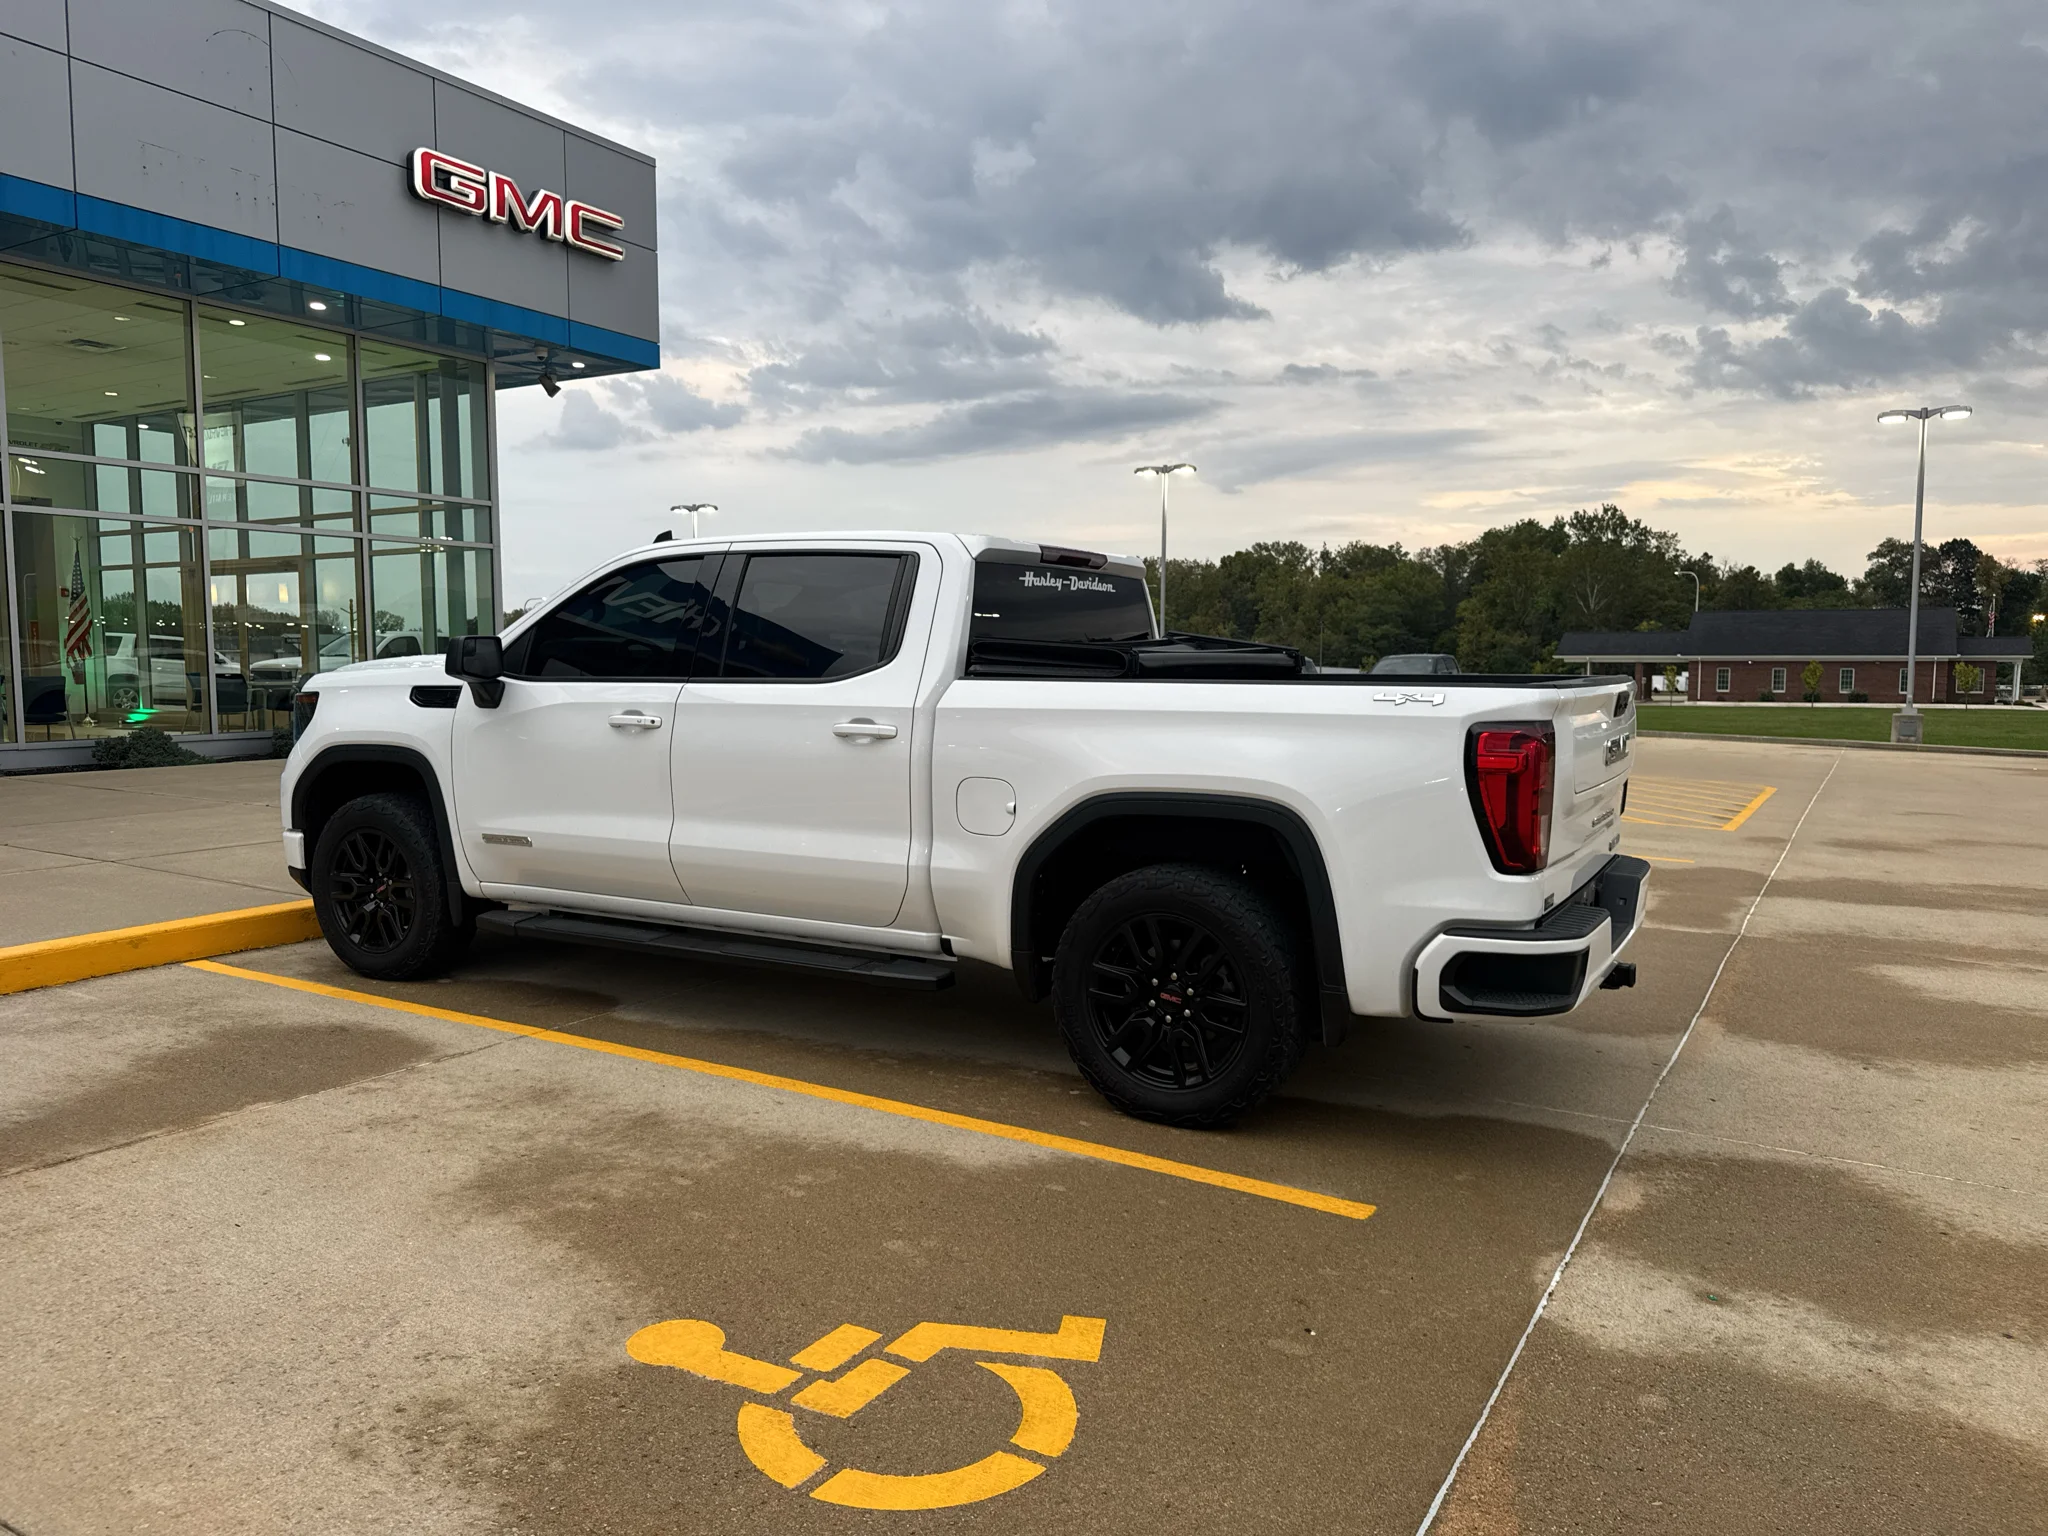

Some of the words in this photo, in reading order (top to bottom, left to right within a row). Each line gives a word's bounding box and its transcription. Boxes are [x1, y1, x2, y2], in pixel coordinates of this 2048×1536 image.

[409, 147, 625, 262] GMC
[8, 439, 39, 448] VROLET
[1019, 571, 1116, 592] Harley-Davidson
